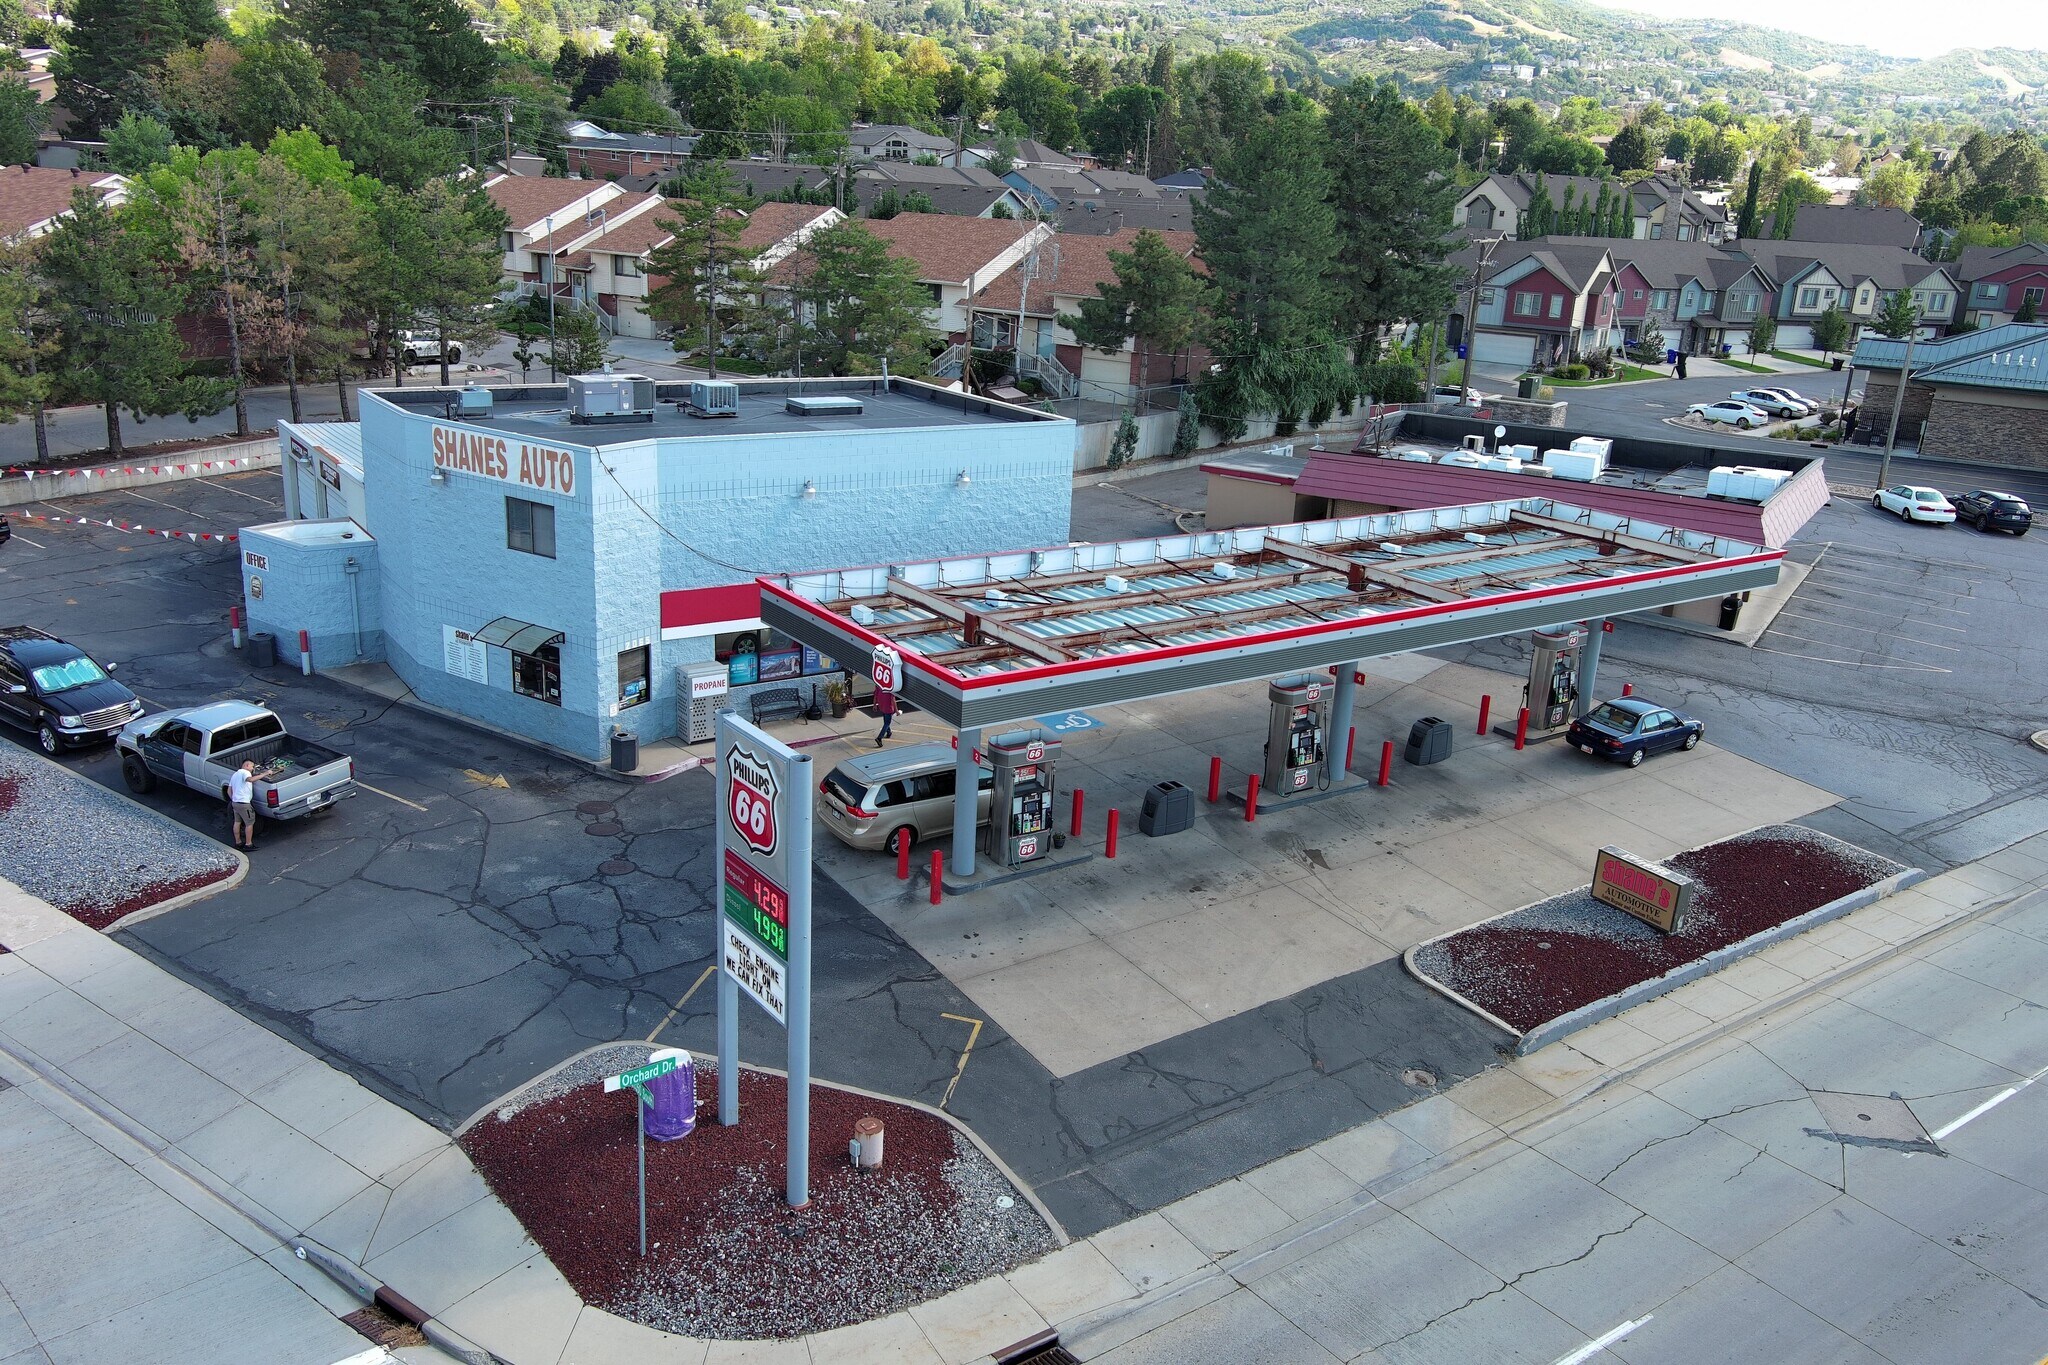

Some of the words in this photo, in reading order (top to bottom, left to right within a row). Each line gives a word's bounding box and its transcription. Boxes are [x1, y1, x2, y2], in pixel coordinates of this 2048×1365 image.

[433, 427, 508, 480] SHANES
[520, 445, 573, 493] AUTO
[245, 551, 268, 571] OFFICE
[694, 679, 726, 692] PROPANE
[875, 665, 891, 684] 66
[1308, 690, 1318, 699] 66
[974, 752, 979, 761] 2
[1029, 749, 1041, 759] 66
[733, 758, 770, 796] PHILLIPS
[1295, 775, 1306, 785] 66
[735, 789, 767, 835] 66
[1021, 844, 1034, 855] 66
[726, 865, 745, 886] Regular
[1603, 860, 1671, 909] shane's
[1605, 888, 1661, 918] AUTOMOTIVE
[730, 934, 751, 960] CHECK
[755, 954, 780, 985] ENGINE
[739, 953, 759, 979] LIGHT
[762, 974, 771, 991] ON
[726, 955, 736, 974] WE
[738, 966, 750, 986] CAN
[752, 978, 763, 998] FIX
[765, 990, 784, 1015] THAT
[621, 1064, 659, 1087] Orchard
[662, 1060, 675, 1073] Dr.
